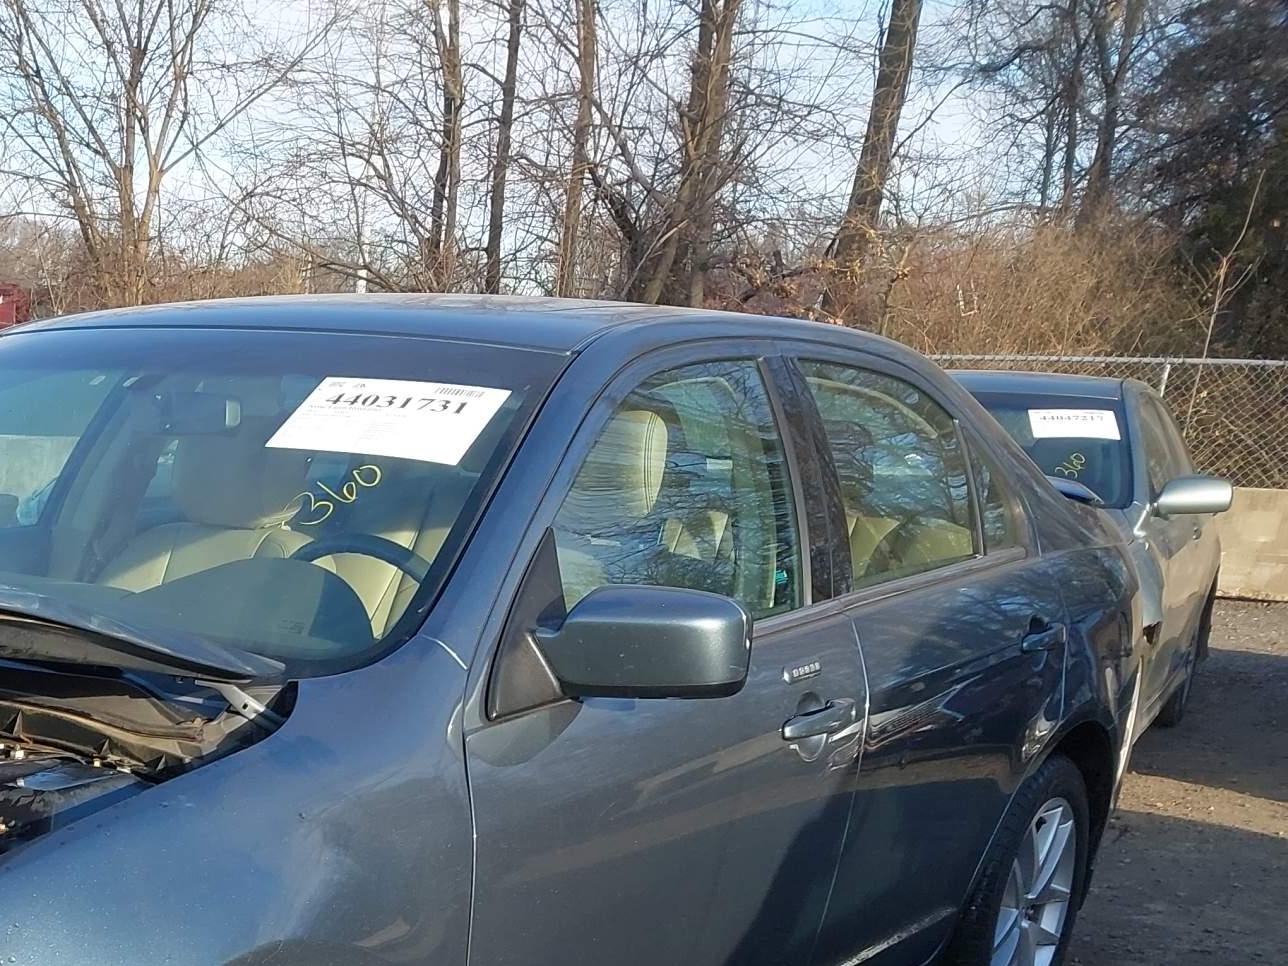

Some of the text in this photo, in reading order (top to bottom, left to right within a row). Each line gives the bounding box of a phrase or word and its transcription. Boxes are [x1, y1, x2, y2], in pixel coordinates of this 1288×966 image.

[325, 392, 468, 416] 44031731
[1054, 452, 1086, 480] 360
[283, 465, 383, 526] 360
